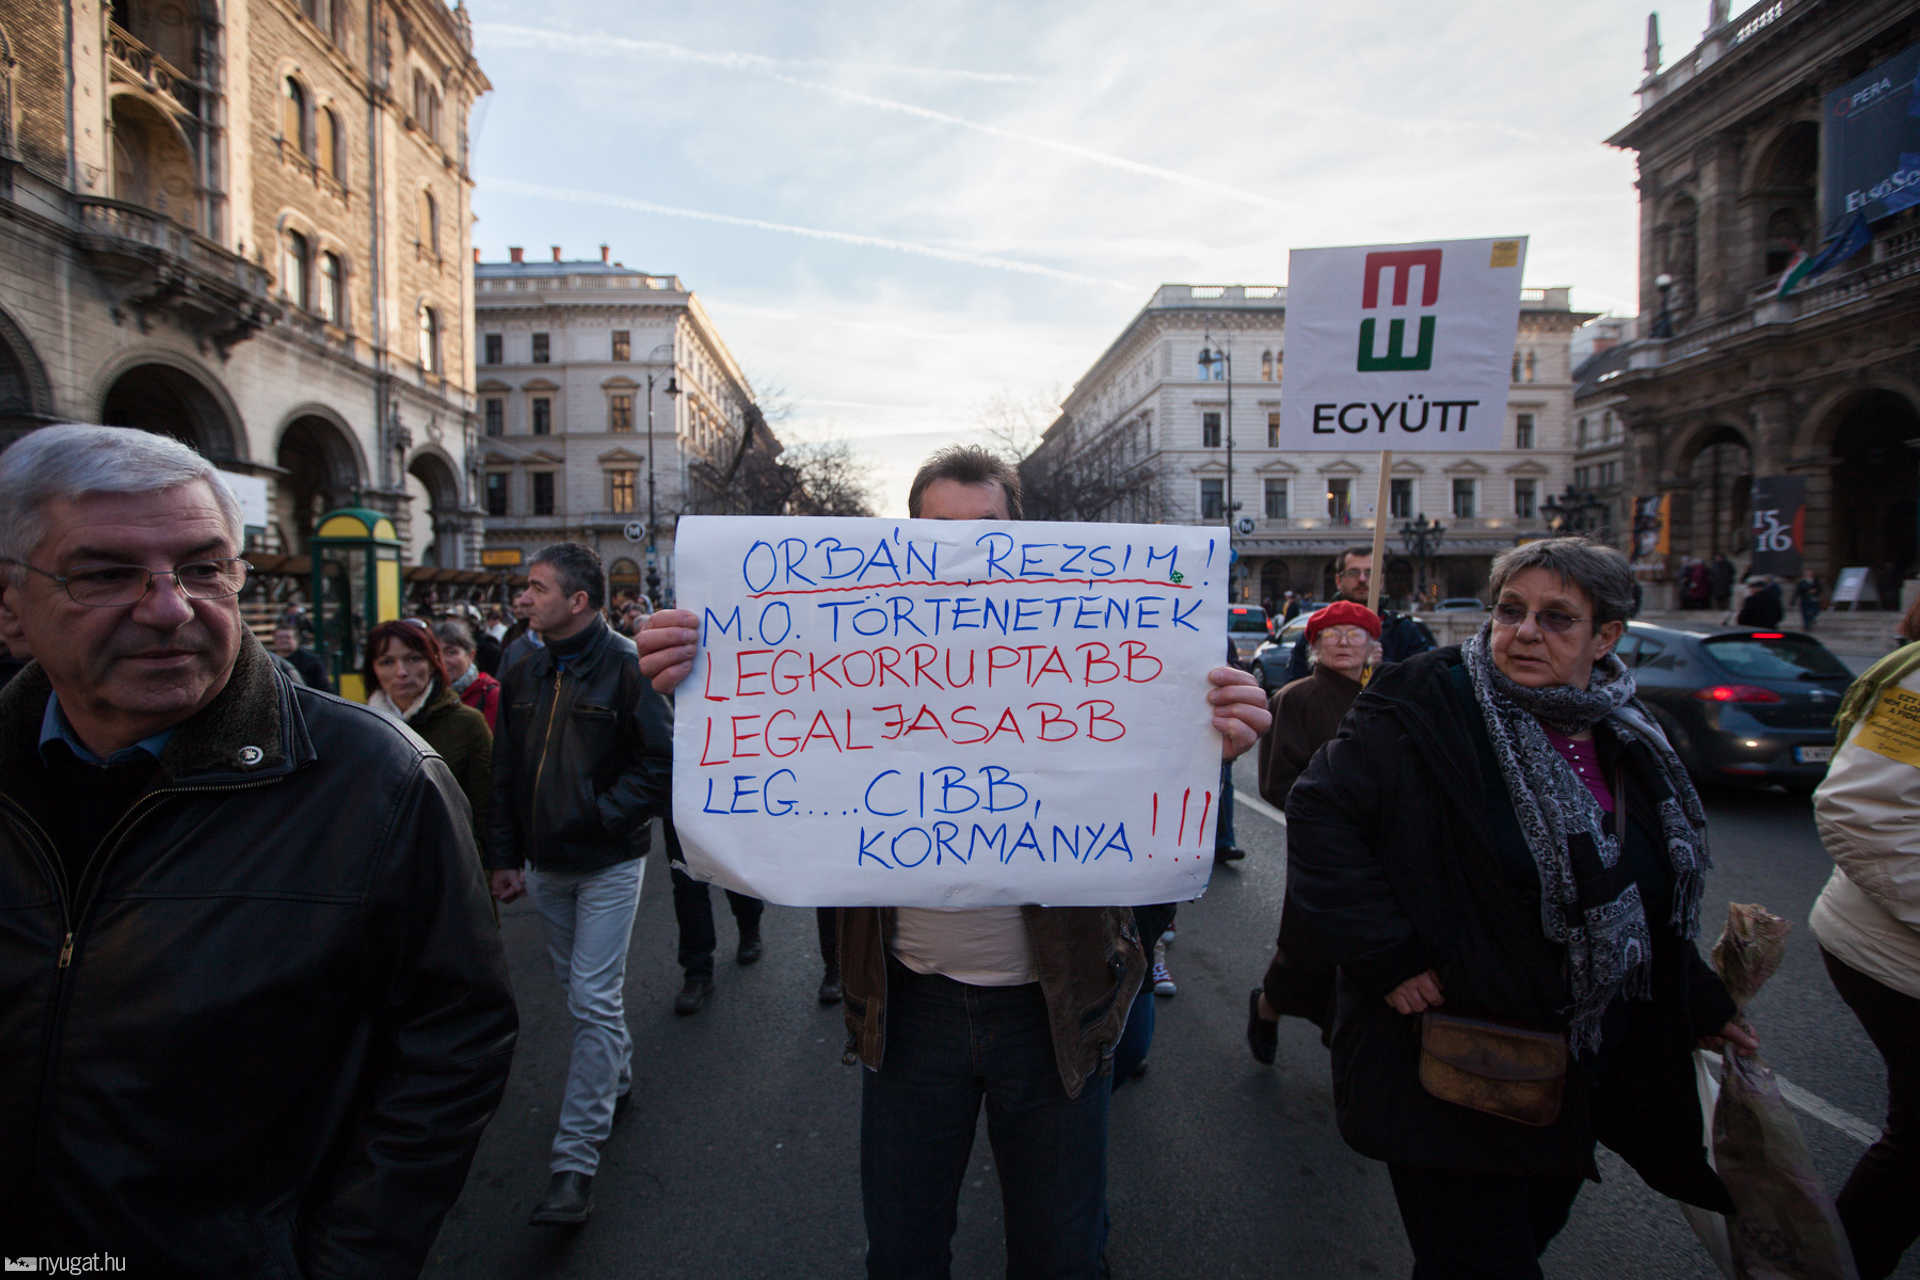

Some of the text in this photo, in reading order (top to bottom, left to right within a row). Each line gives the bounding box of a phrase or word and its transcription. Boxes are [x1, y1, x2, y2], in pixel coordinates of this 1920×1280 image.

[1834, 77, 1892, 117] OPERA
[1312, 393, 1480, 434] EGYÜTT
[742, 527, 939, 595] ORBÁN
[702, 601, 801, 648] M.O.
[702, 640, 1164, 701] LEGKORRUPTABB
[699, 700, 1127, 766] LEGALJASABB
